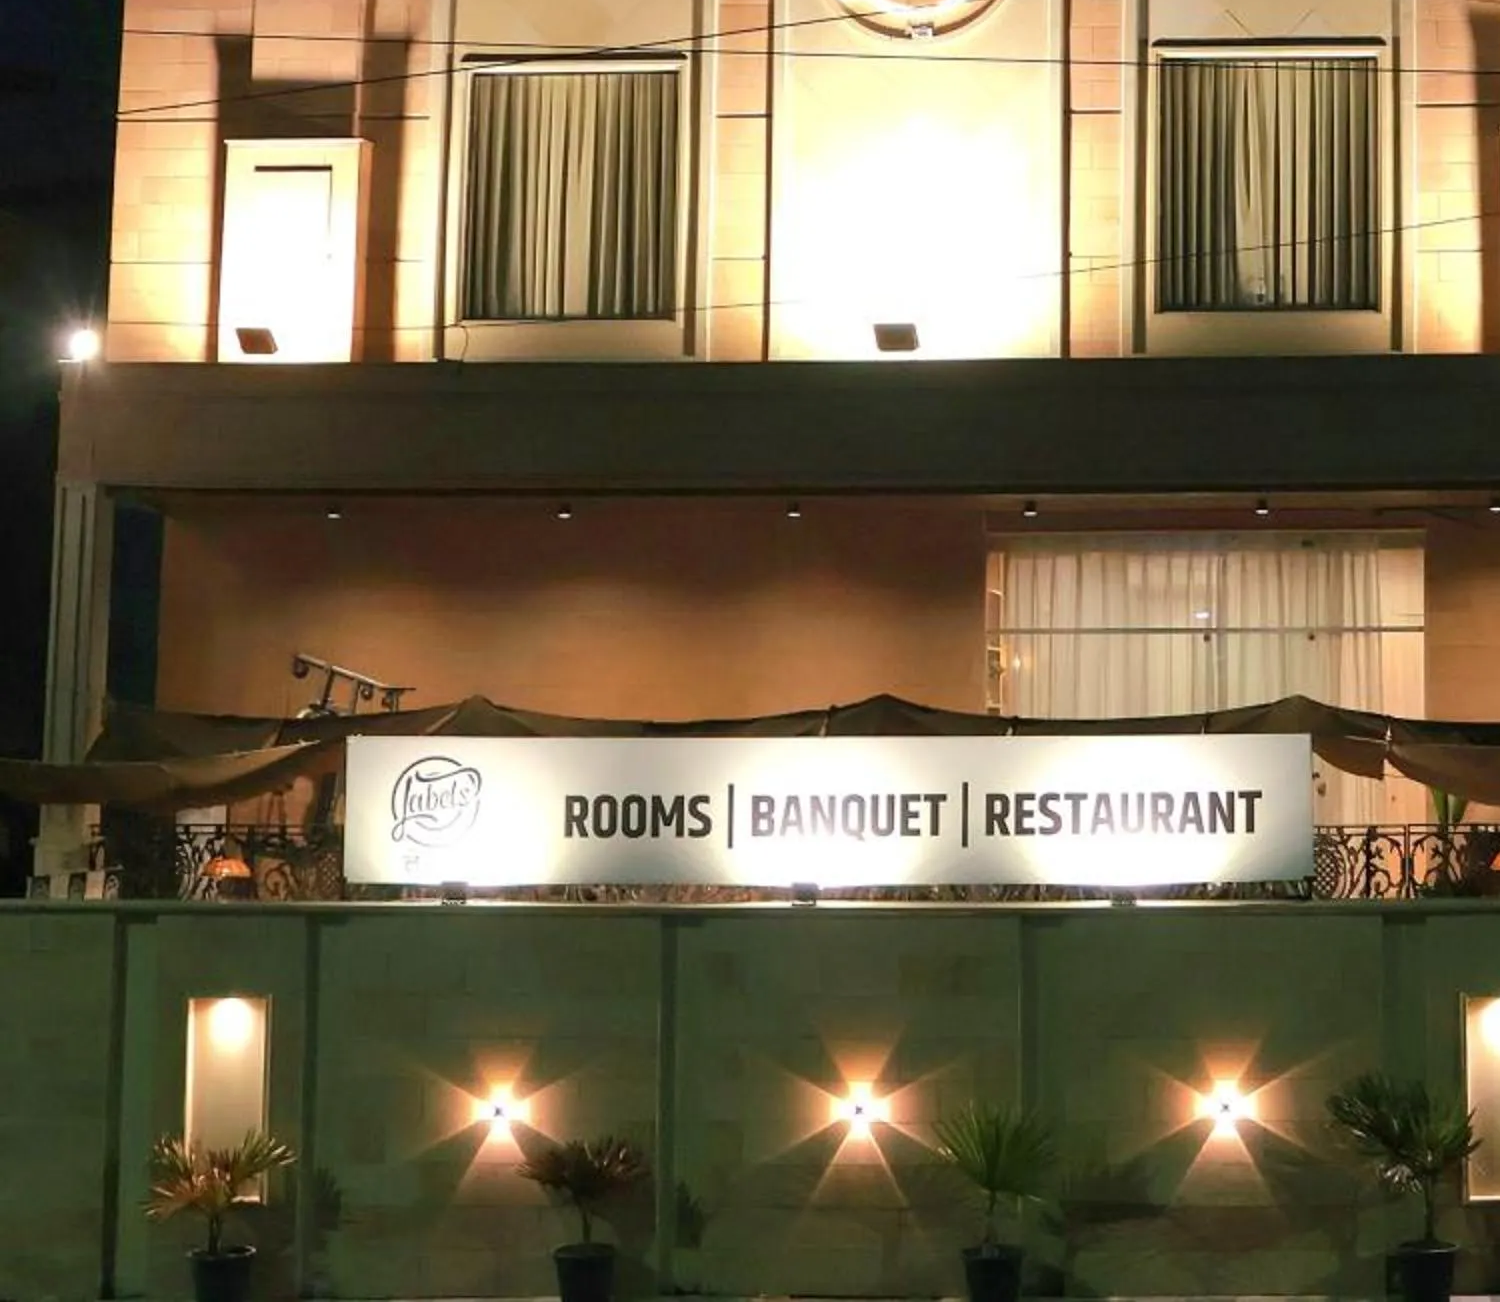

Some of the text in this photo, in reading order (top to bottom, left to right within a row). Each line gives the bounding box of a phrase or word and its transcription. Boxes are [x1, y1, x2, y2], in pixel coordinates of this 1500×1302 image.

[564, 790, 1263, 841] ROOMS BANQUET RESTAURANT
